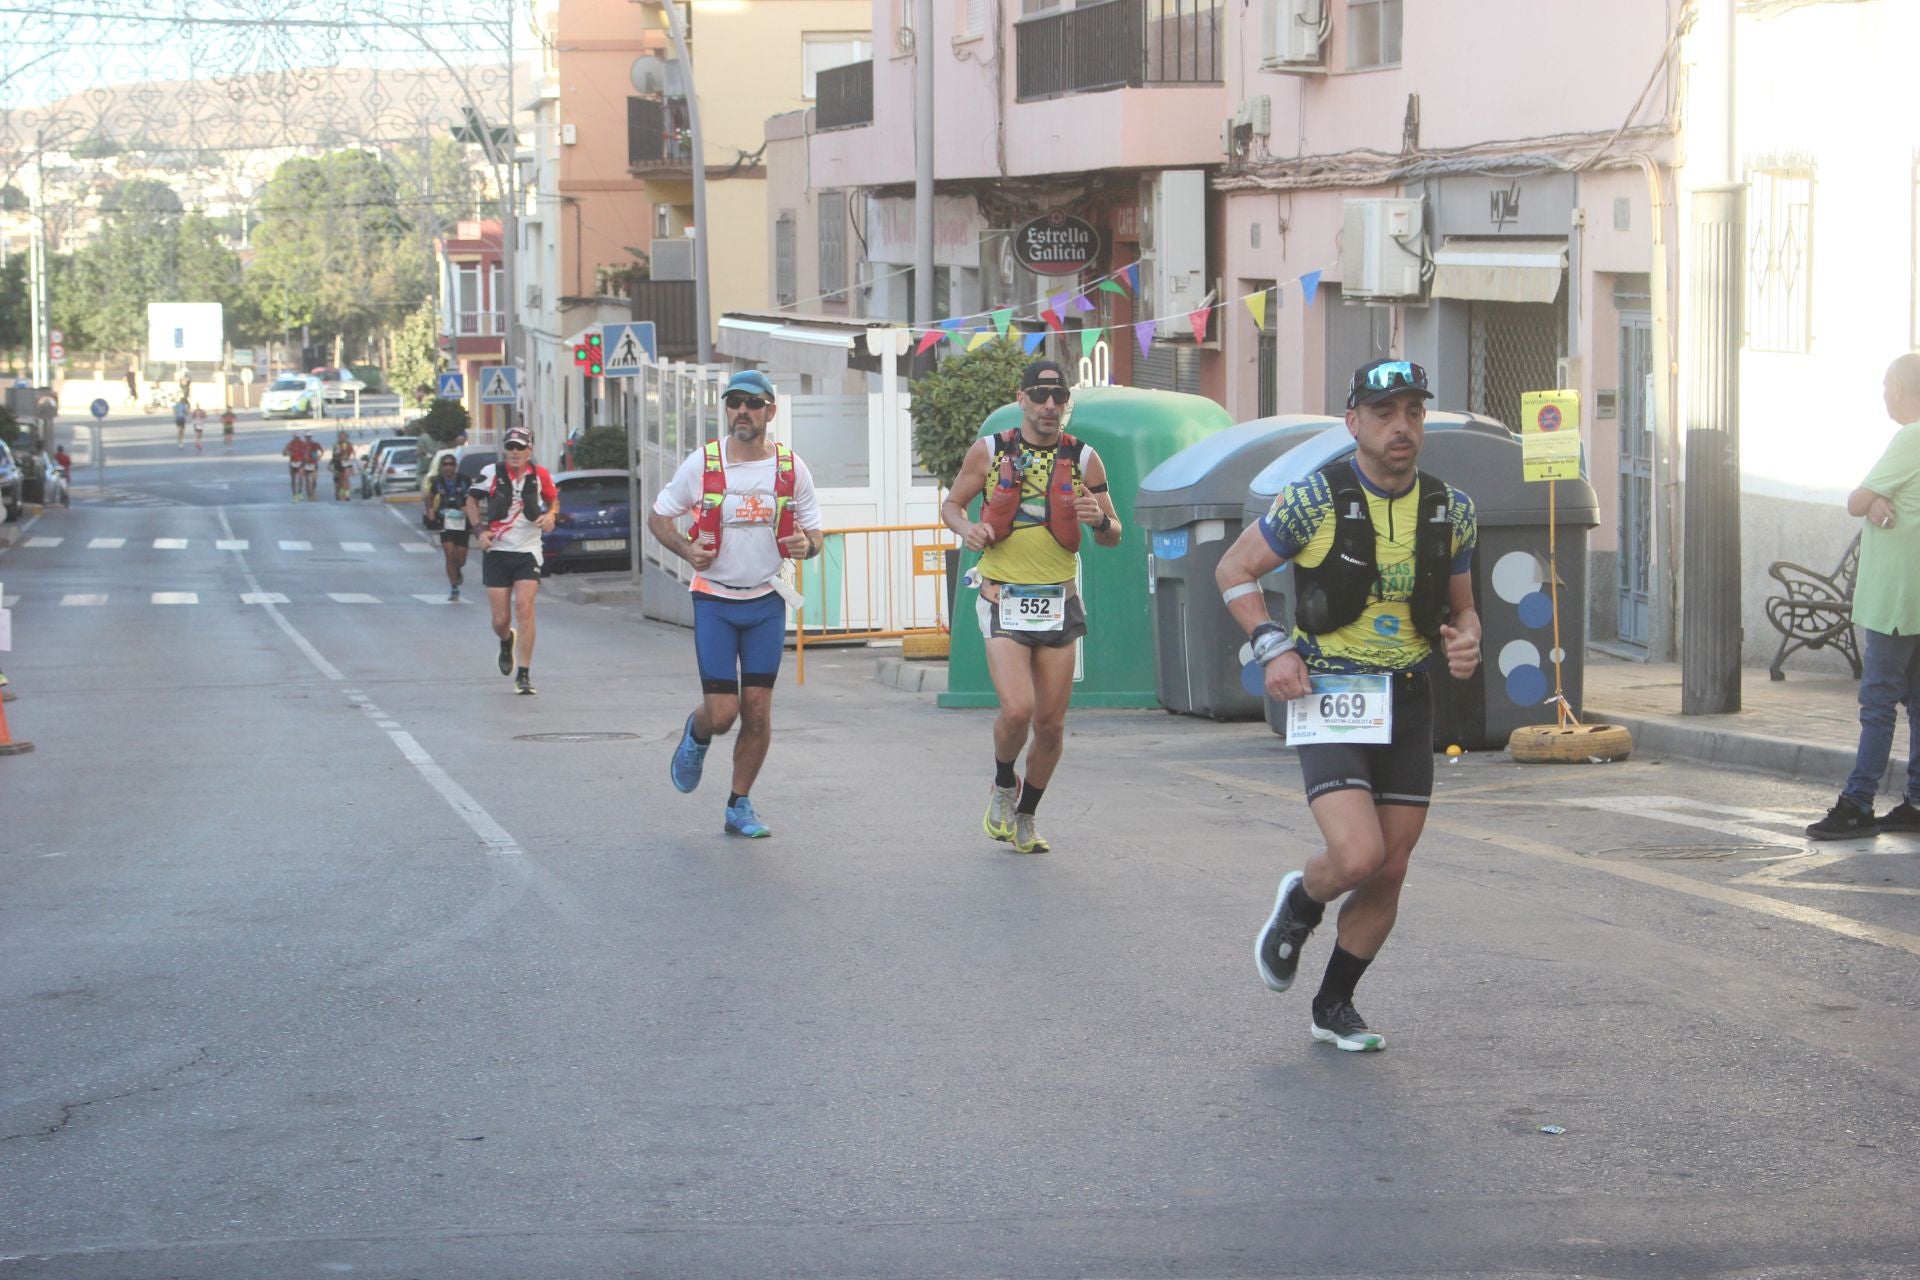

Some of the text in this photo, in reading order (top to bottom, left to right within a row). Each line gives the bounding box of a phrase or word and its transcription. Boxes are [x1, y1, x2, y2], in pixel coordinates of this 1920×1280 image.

[1026, 227, 1089, 244] Estrella
[1029, 243, 1086, 261] Galicia
[1340, 553, 1368, 567] SALOMON
[1020, 598, 1050, 615] 552
[1319, 693, 1367, 719] 669
